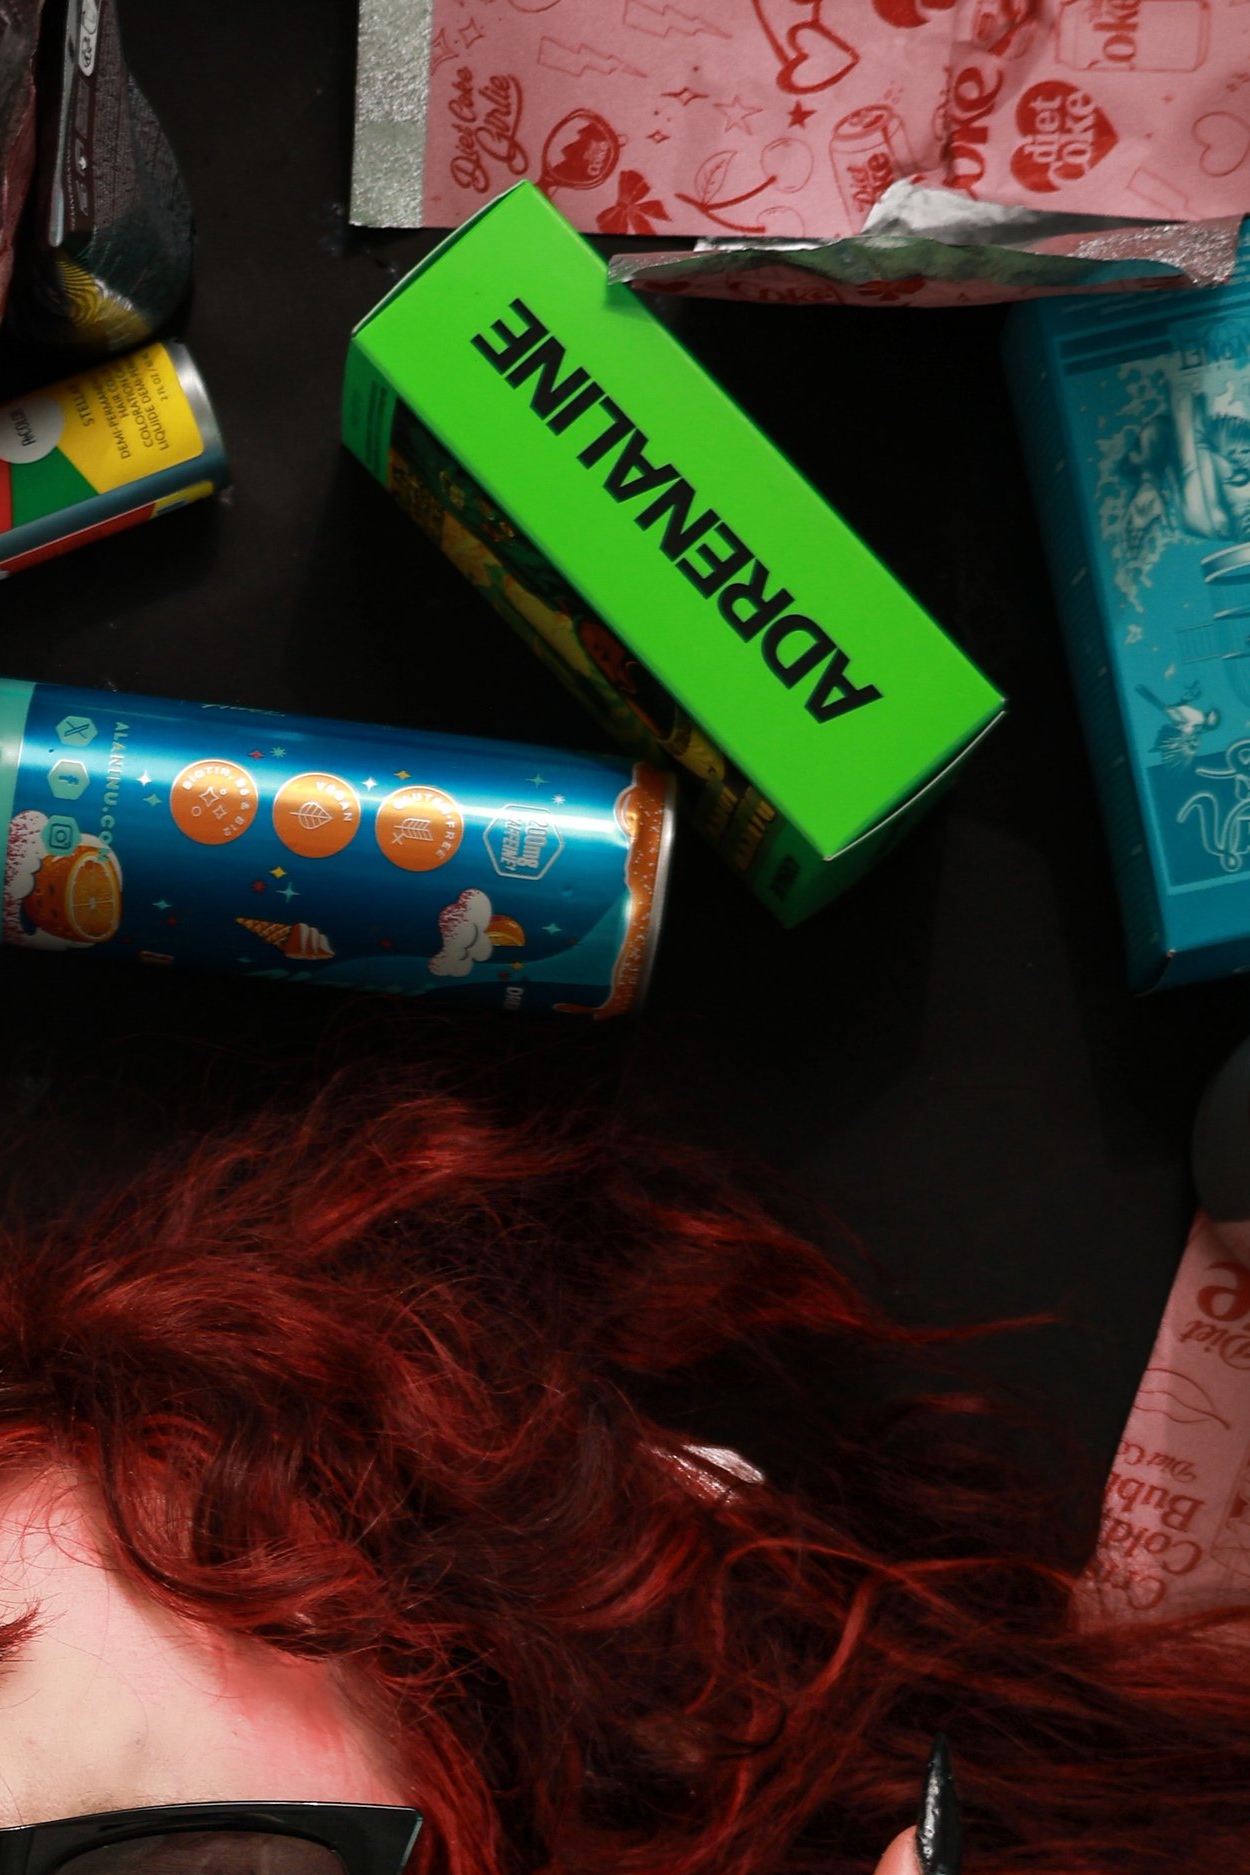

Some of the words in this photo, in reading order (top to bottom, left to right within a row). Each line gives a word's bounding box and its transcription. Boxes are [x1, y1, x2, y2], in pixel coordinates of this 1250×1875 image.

[448, 66, 475, 119] Coke
[474, 73, 527, 174] Girlie
[940, 66, 1002, 189] oke
[1024, 95, 1060, 162] diet
[450, 124, 488, 193] Diet
[116, 393, 127, 418] HAIR
[150, 373, 159, 384] OZ
[158, 384, 166, 395] FL
[123, 379, 153, 448] COLORATION
[148, 405, 168, 450] LIQUIDE
[472, 298, 883, 723] ADRENALINE
[95, 721, 129, 862] ALANINU.COM
[316, 781, 352, 821] VEGAN
[517, 819, 547, 868] 200mg
[1147, 1451, 1196, 1482] Diet
[1104, 1471, 1203, 1531] Bub
